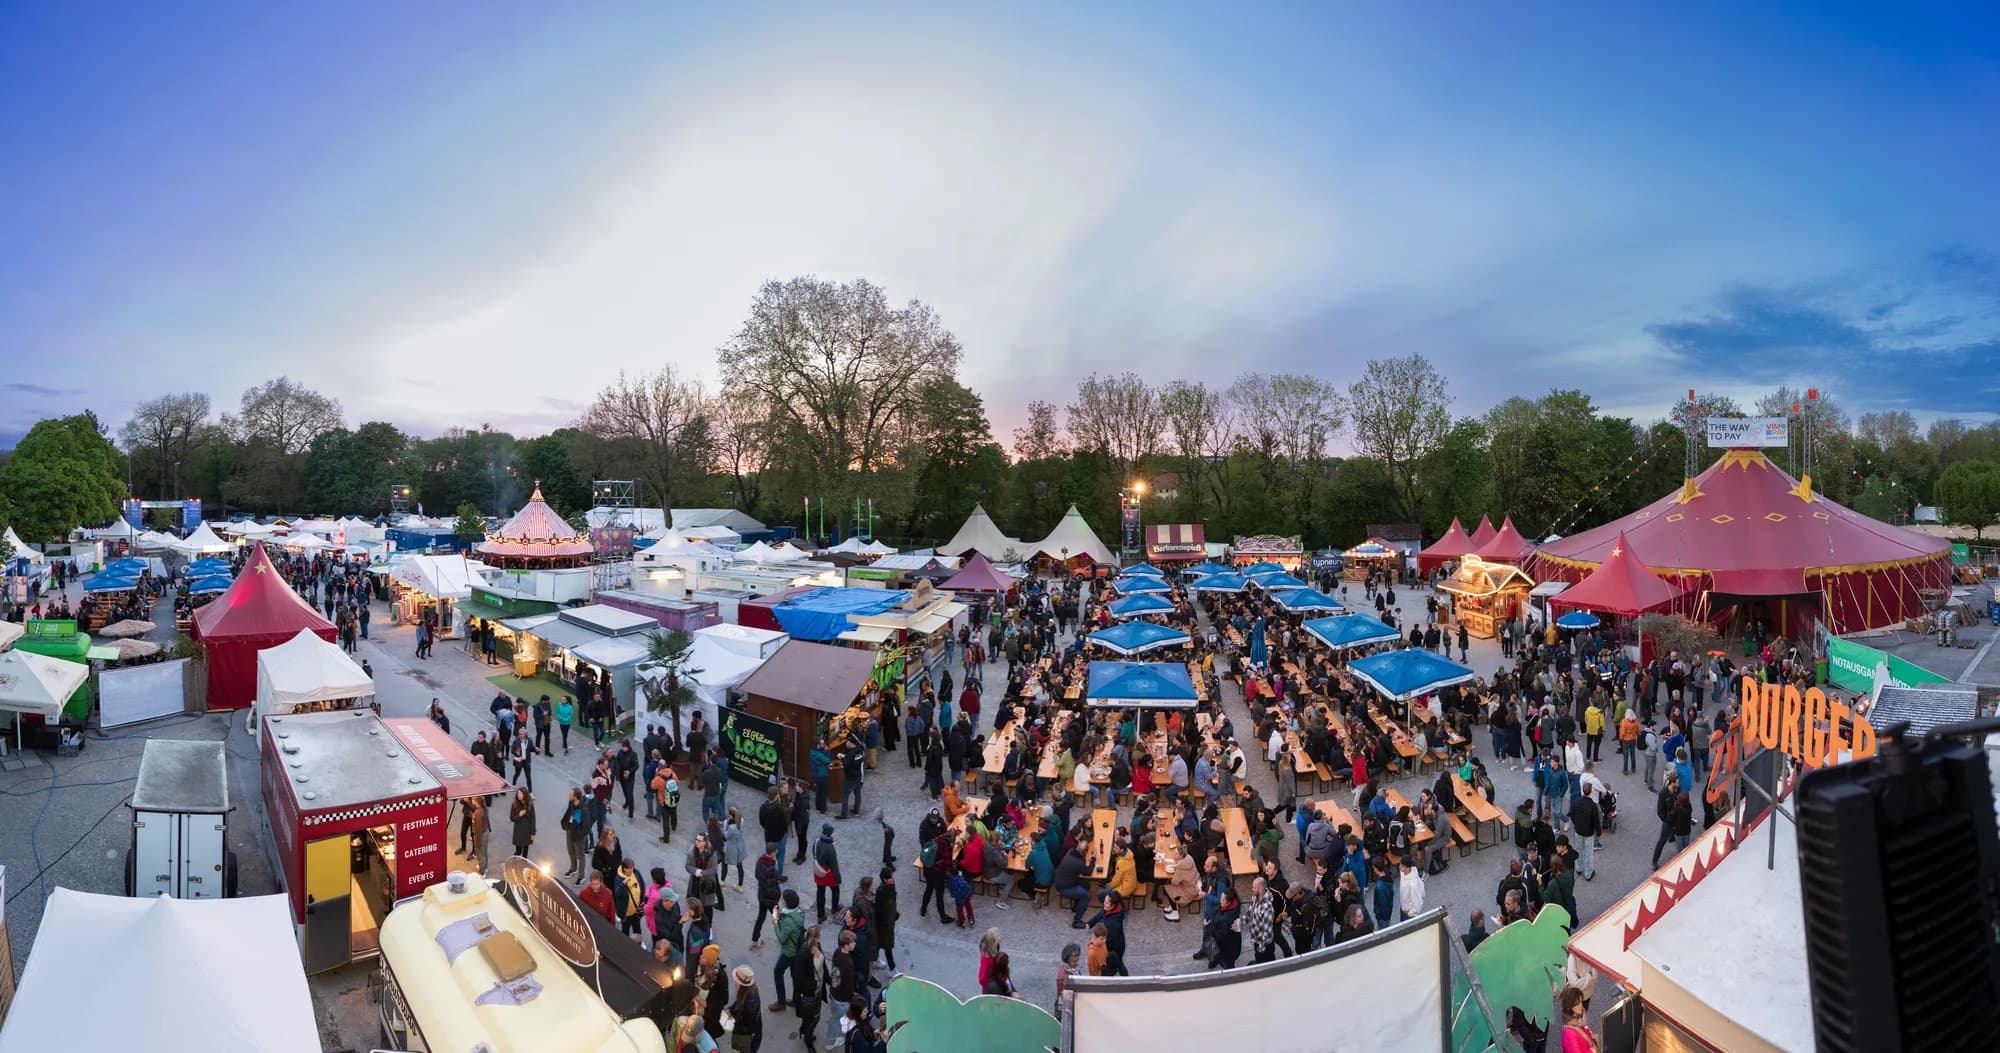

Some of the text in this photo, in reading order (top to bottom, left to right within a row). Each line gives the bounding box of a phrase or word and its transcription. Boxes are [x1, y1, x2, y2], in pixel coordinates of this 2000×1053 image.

[1833, 655, 1876, 679] NOTAUSGAN
[735, 735, 778, 763] LOCO
[403, 815, 439, 831] FESTIVALS
[404, 843, 438, 859] CATERING
[408, 871, 435, 885] EVENTS
[542, 890, 586, 940] CHURROS
